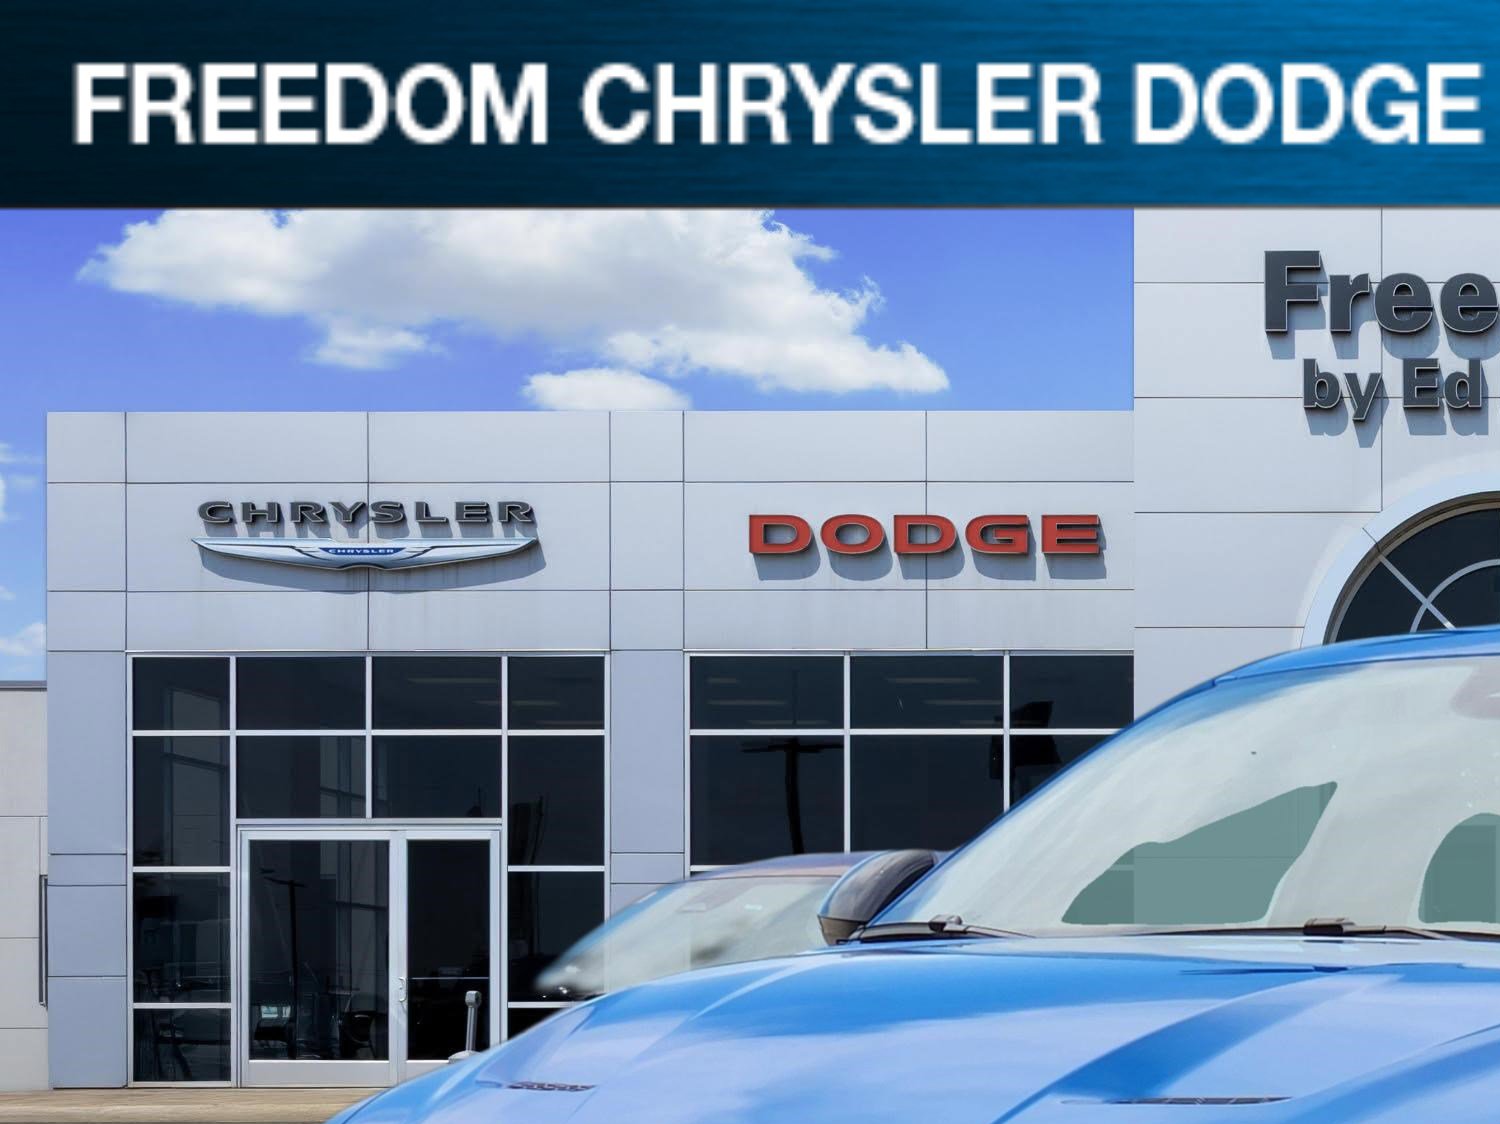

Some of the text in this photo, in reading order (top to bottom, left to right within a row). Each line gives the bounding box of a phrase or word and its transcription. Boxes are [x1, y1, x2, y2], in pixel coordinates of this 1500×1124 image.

[1303, 358, 1381, 421] by
[1402, 358, 1483, 409] Ed
[198, 500, 533, 524] CHRYSLER
[748, 514, 1100, 554] DODGE
